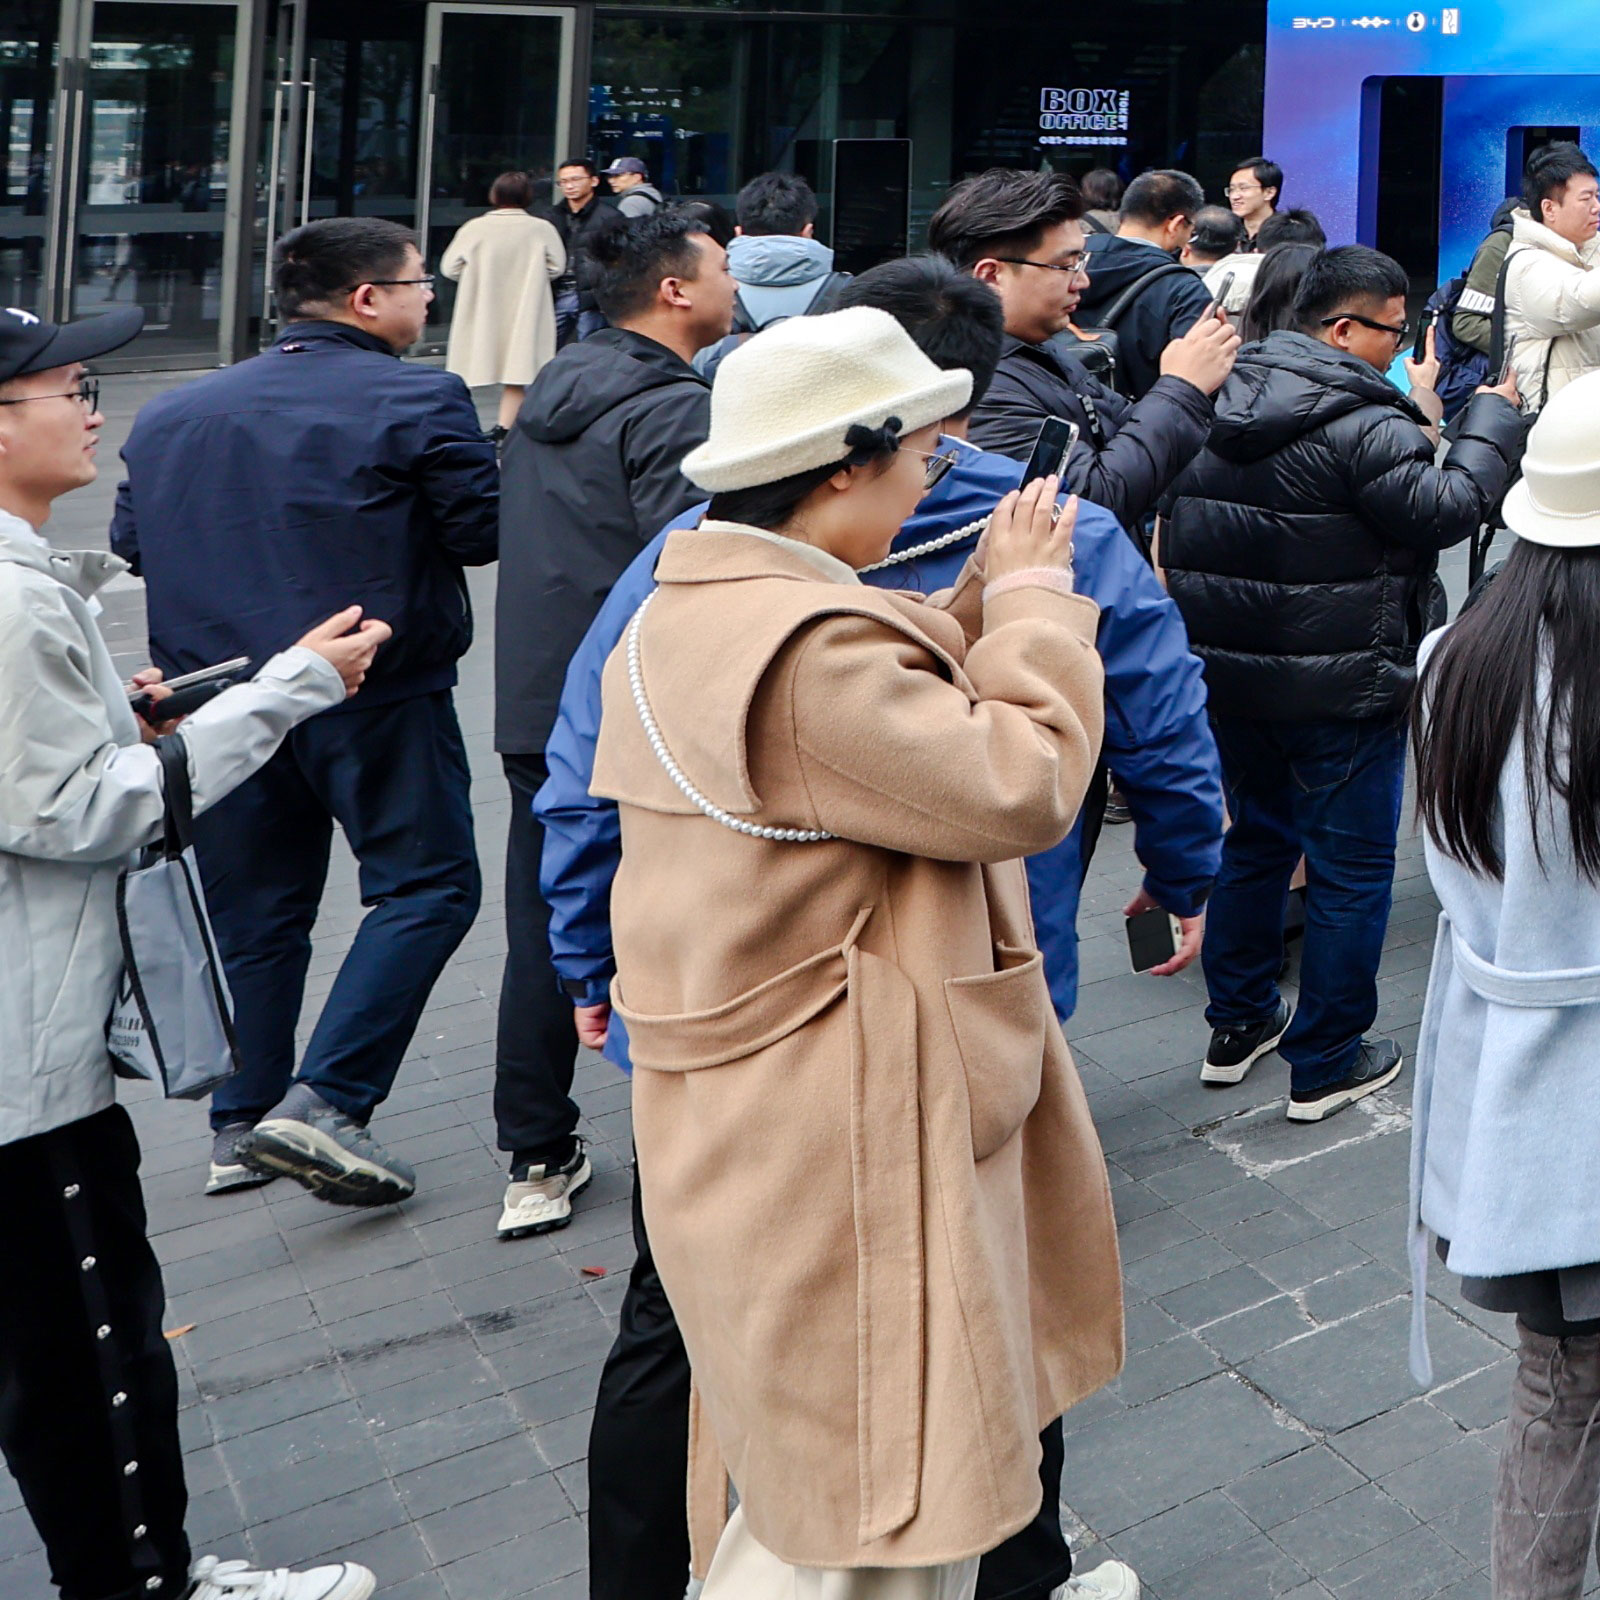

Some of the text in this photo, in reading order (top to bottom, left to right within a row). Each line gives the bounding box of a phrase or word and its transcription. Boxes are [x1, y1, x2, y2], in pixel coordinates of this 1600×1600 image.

[1292, 17, 1336, 29] BYD
[1040, 87, 1118, 114] BOX
[1039, 113, 1118, 131] OFFICE
